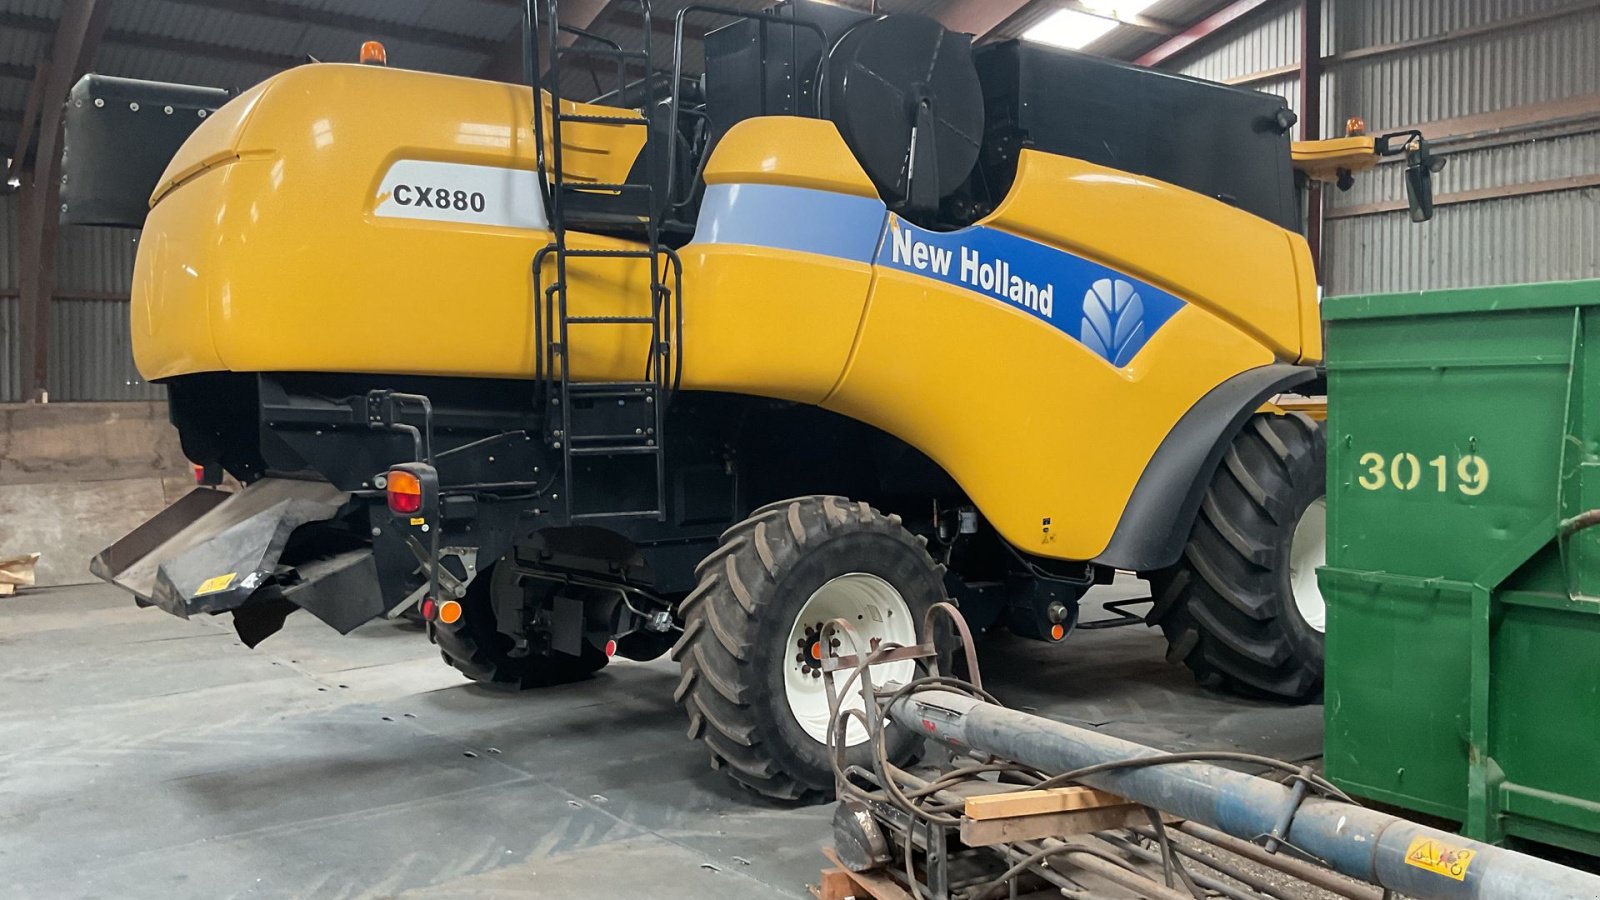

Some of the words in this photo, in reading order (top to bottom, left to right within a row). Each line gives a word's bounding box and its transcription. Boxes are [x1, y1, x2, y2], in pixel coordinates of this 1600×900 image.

[393, 184, 486, 213] CX880
[892, 228, 953, 276] New
[960, 246, 1054, 319] Holland
[1358, 452, 1489, 496] 3019
